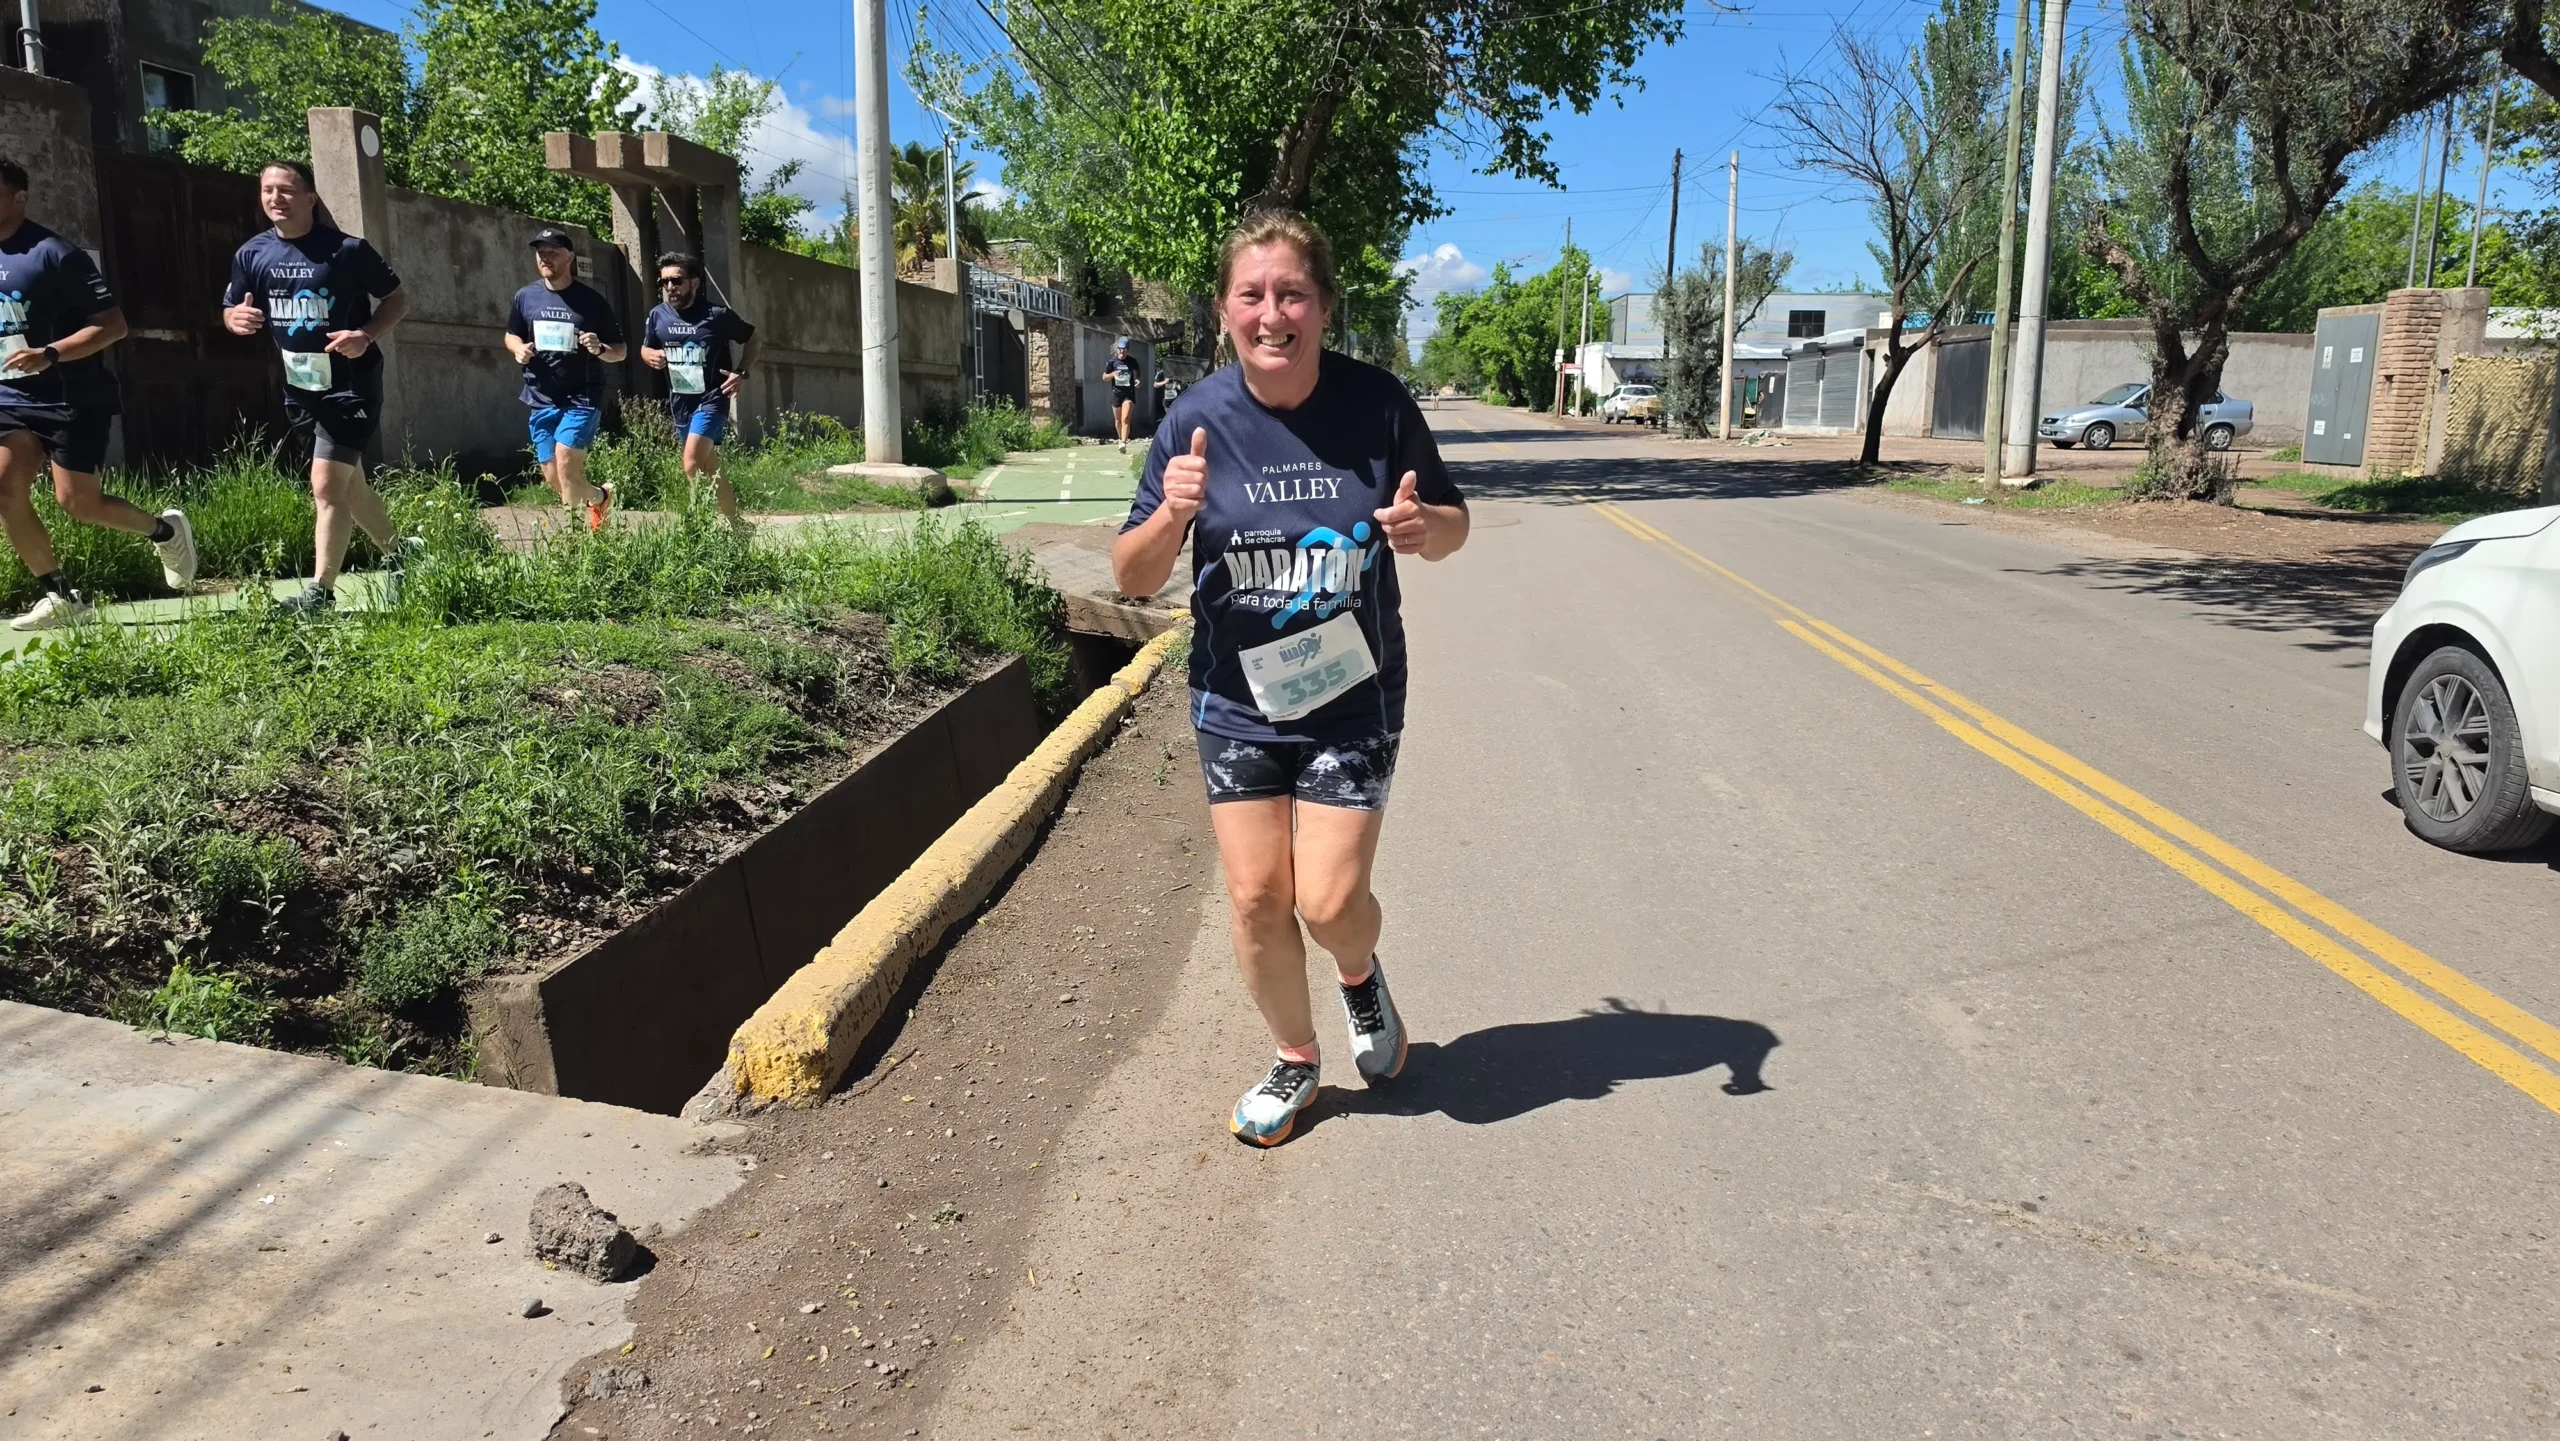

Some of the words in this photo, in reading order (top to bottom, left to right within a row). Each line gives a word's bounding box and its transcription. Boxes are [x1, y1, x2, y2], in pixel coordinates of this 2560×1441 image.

[270, 268, 315, 279] VALLEY
[541, 310, 573, 320] VALLEY
[668, 326, 698, 335] VALLEY
[1262, 462, 1322, 474] PALMARES
[1243, 478, 1342, 503] VALLEY
[1244, 528, 1281, 538] parroquia
[1256, 536, 1286, 544] chacras
[1230, 593, 1259, 607] para
[1263, 595, 1293, 609] toda
[1298, 597, 1310, 610] la
[1313, 596, 1362, 611] familia
[1281, 660, 1347, 706] 335
